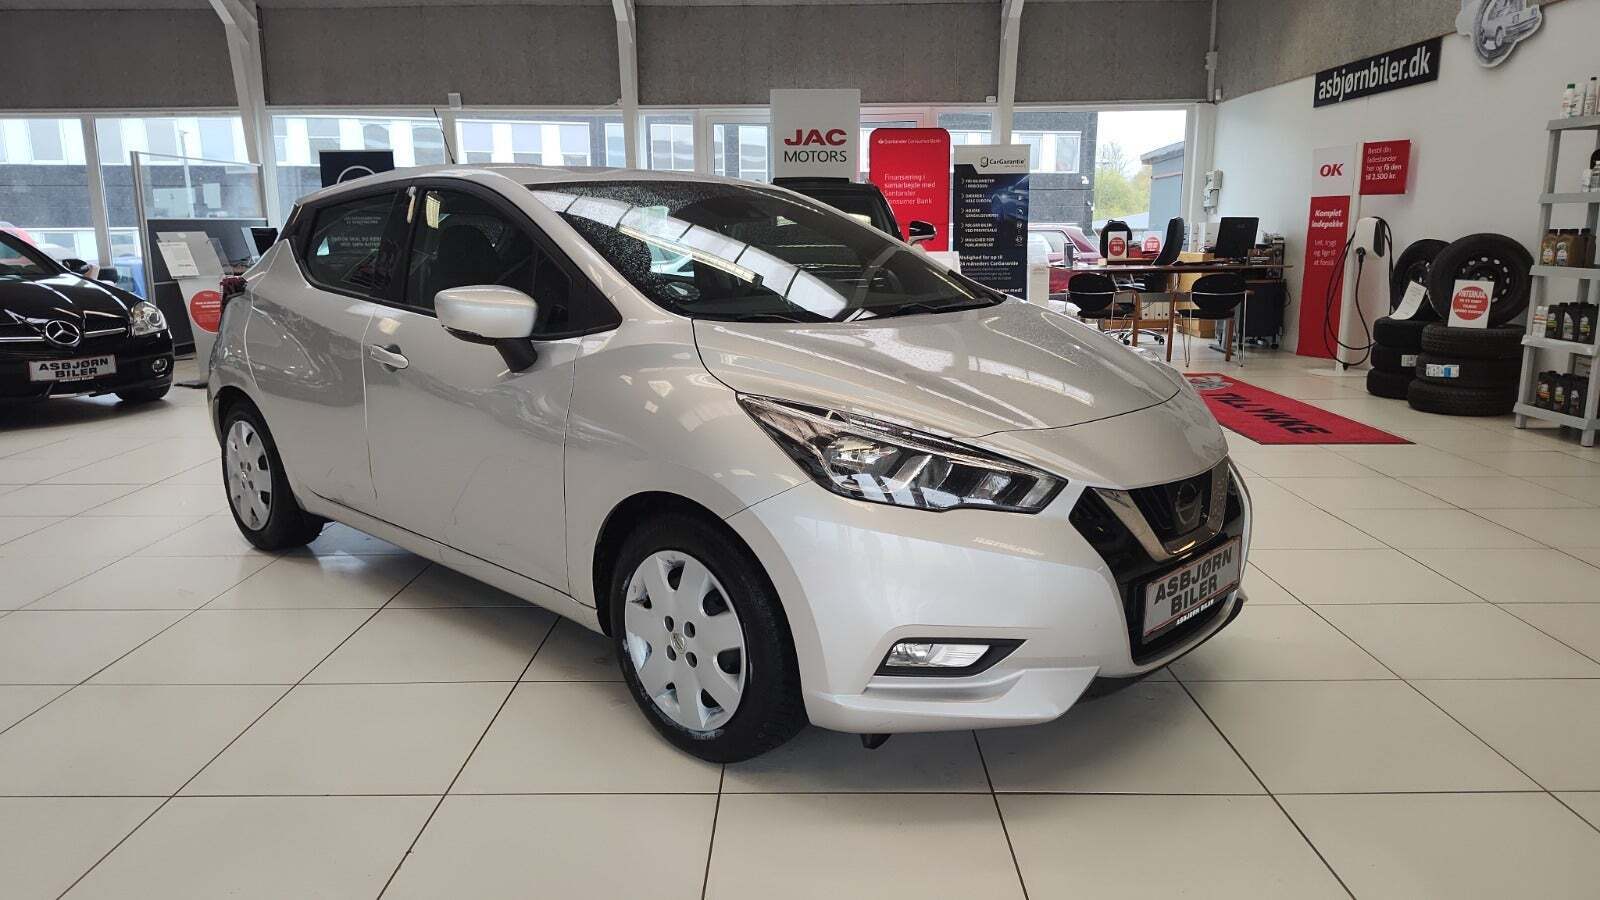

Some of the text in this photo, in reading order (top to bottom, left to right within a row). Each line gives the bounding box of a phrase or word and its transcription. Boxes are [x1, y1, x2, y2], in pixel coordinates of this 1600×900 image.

[1318, 46, 1431, 102] asbjørnbiler.dk
[784, 129, 847, 145] JAC
[784, 150, 847, 162] MOTORS
[1320, 163, 1344, 177] OK
[1315, 209, 1342, 218] Komplet
[1312, 219, 1344, 229] ladepakke
[39, 358, 109, 371] ASBJØRN
[55, 367, 97, 378] BILER
[1154, 549, 1232, 605] ASBJØRN
[1170, 575, 1218, 617] BILER
